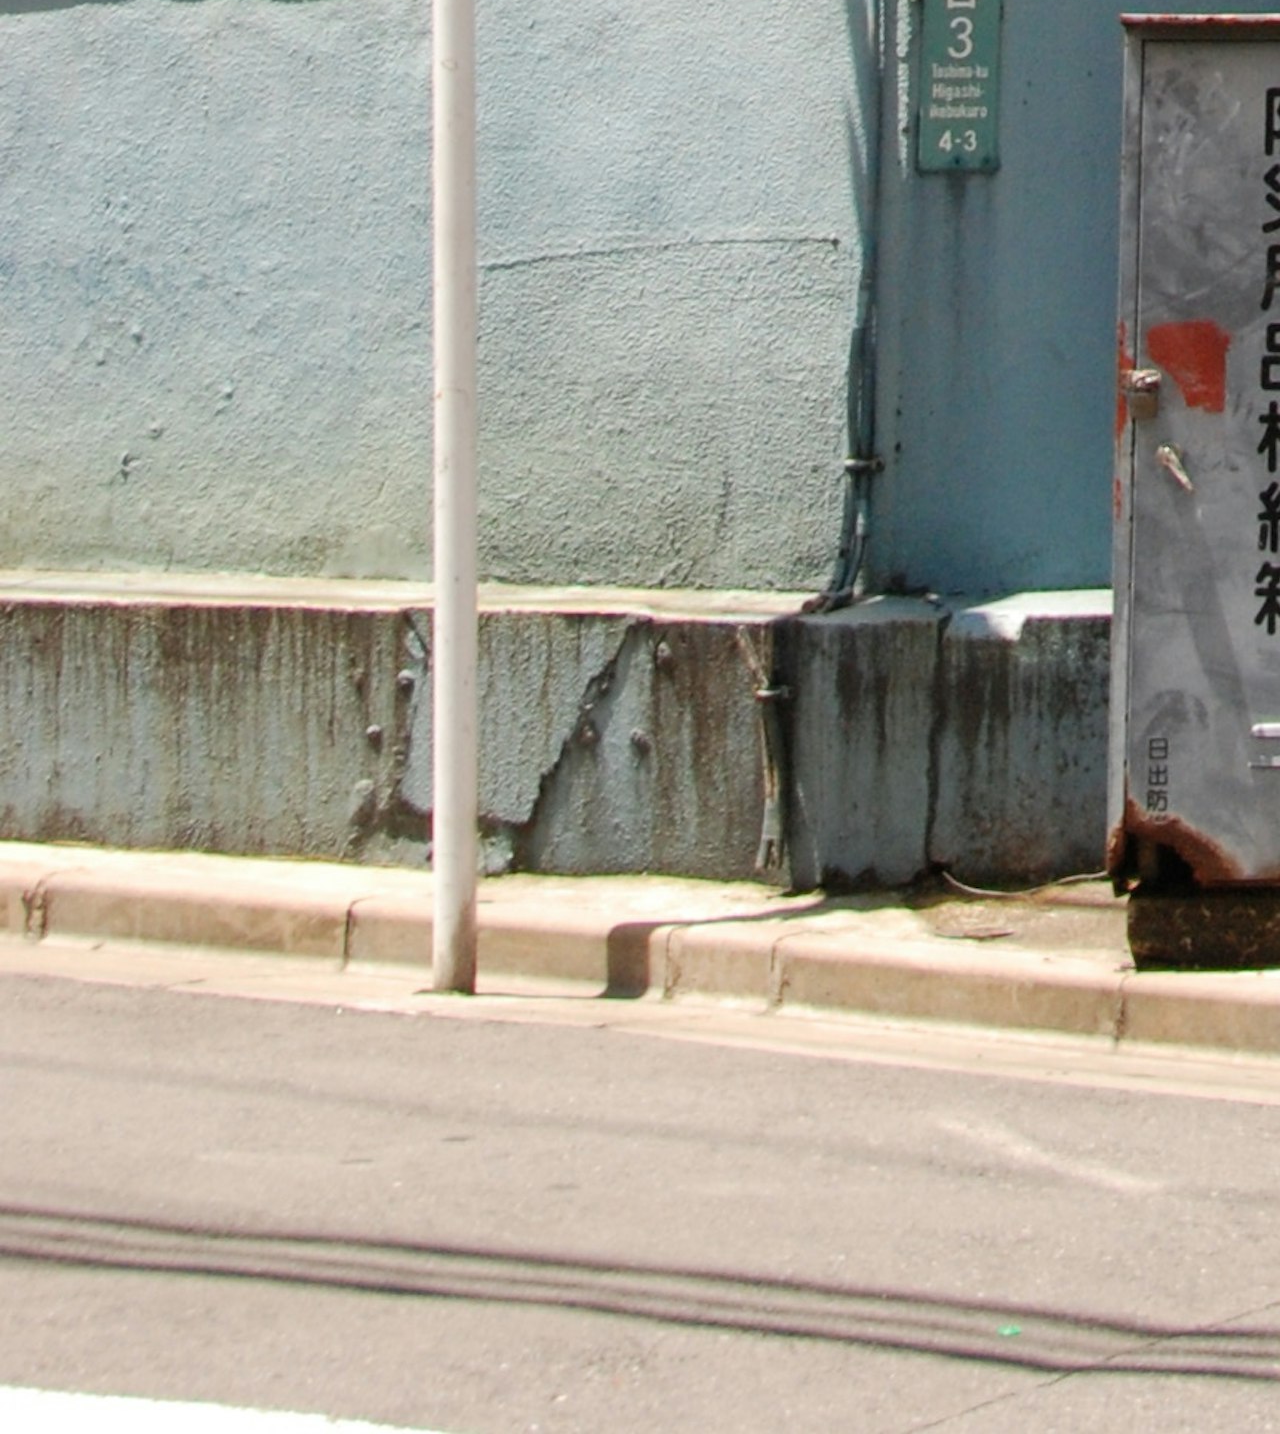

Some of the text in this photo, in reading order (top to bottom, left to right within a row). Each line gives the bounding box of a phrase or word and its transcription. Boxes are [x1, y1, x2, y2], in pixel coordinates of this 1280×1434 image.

[938, 129, 977, 152] 4-3
[1147, 737, 1169, 821] 日出防
